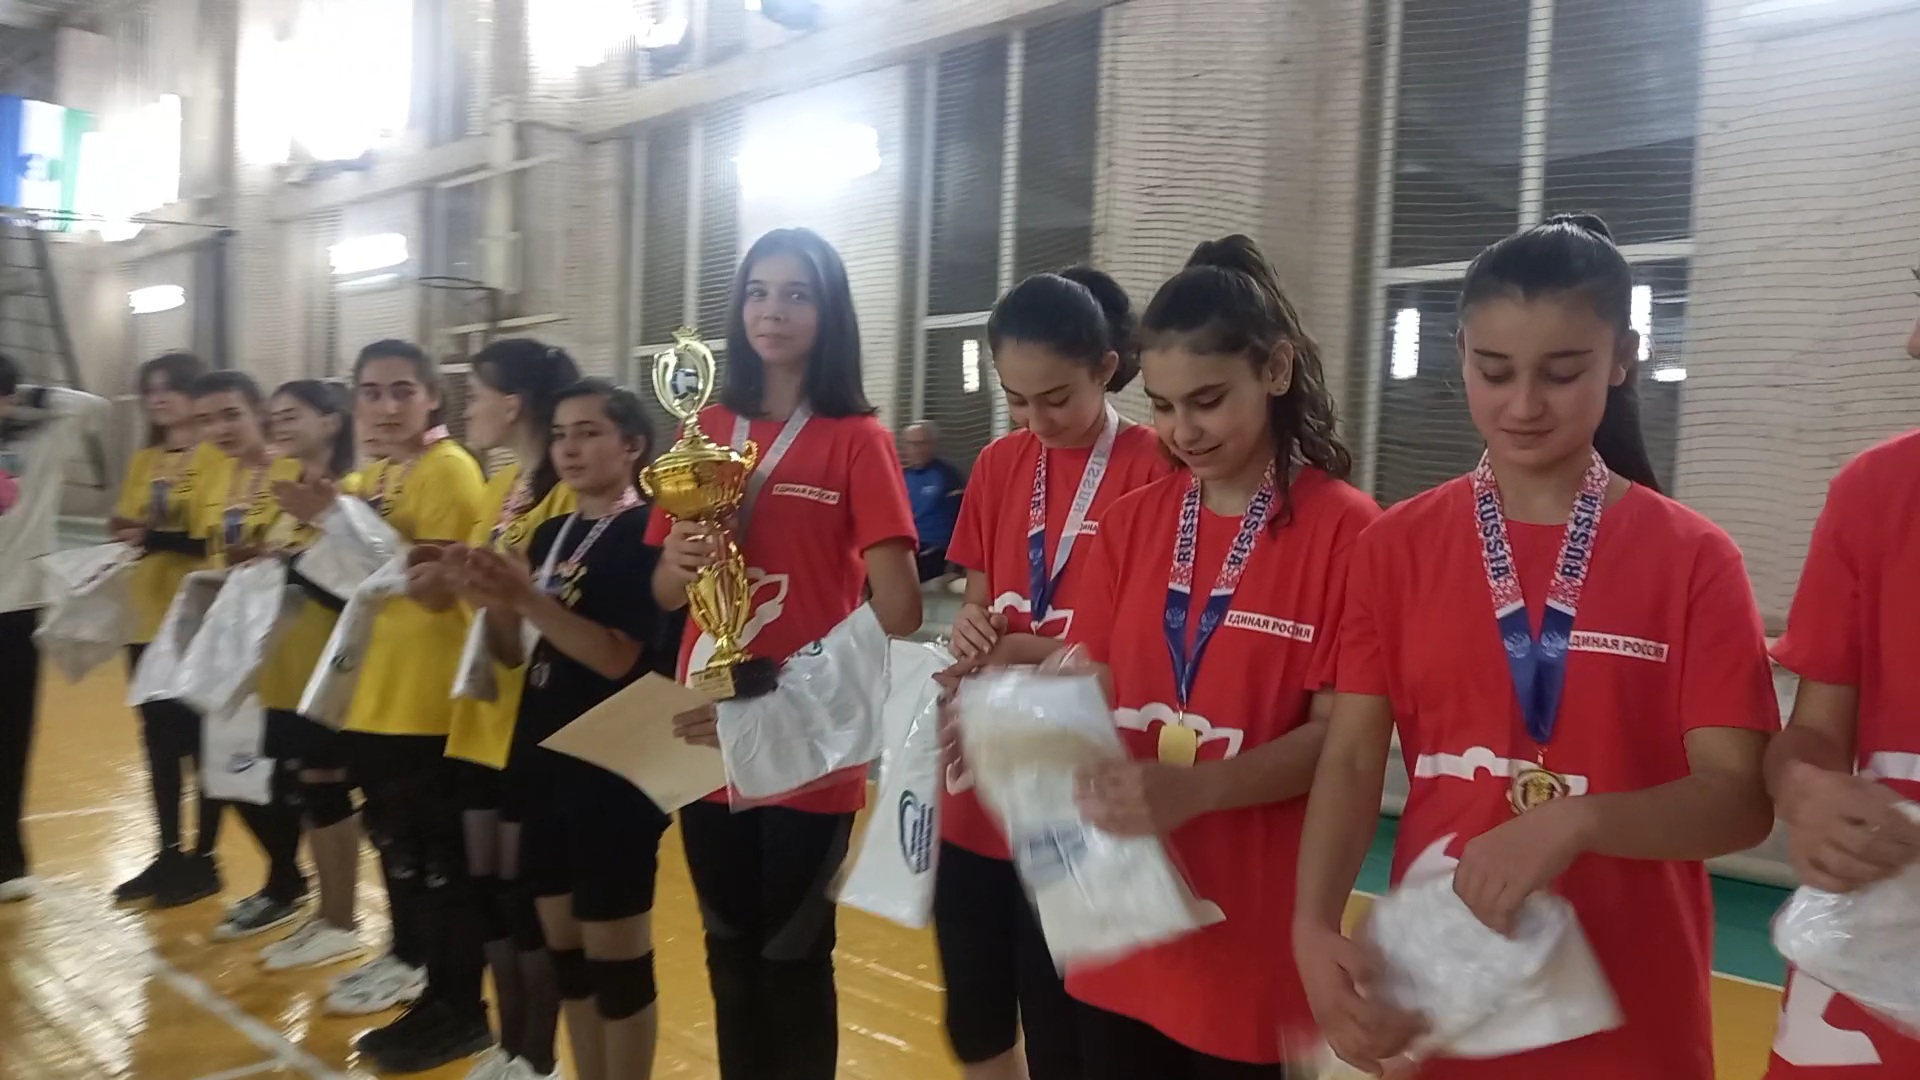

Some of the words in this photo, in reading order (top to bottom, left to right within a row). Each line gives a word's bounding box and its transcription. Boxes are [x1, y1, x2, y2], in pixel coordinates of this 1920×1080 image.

[1177, 488, 1200, 563] RUSSIA
[1227, 487, 1273, 566] RUSSIA
[1477, 491, 1511, 581] RUSSIA
[1560, 492, 1599, 579] RUSSIA
[1228, 613, 1270, 630] ЕДИНАЯ
[1570, 634, 1620, 651] ДИНАЯ
